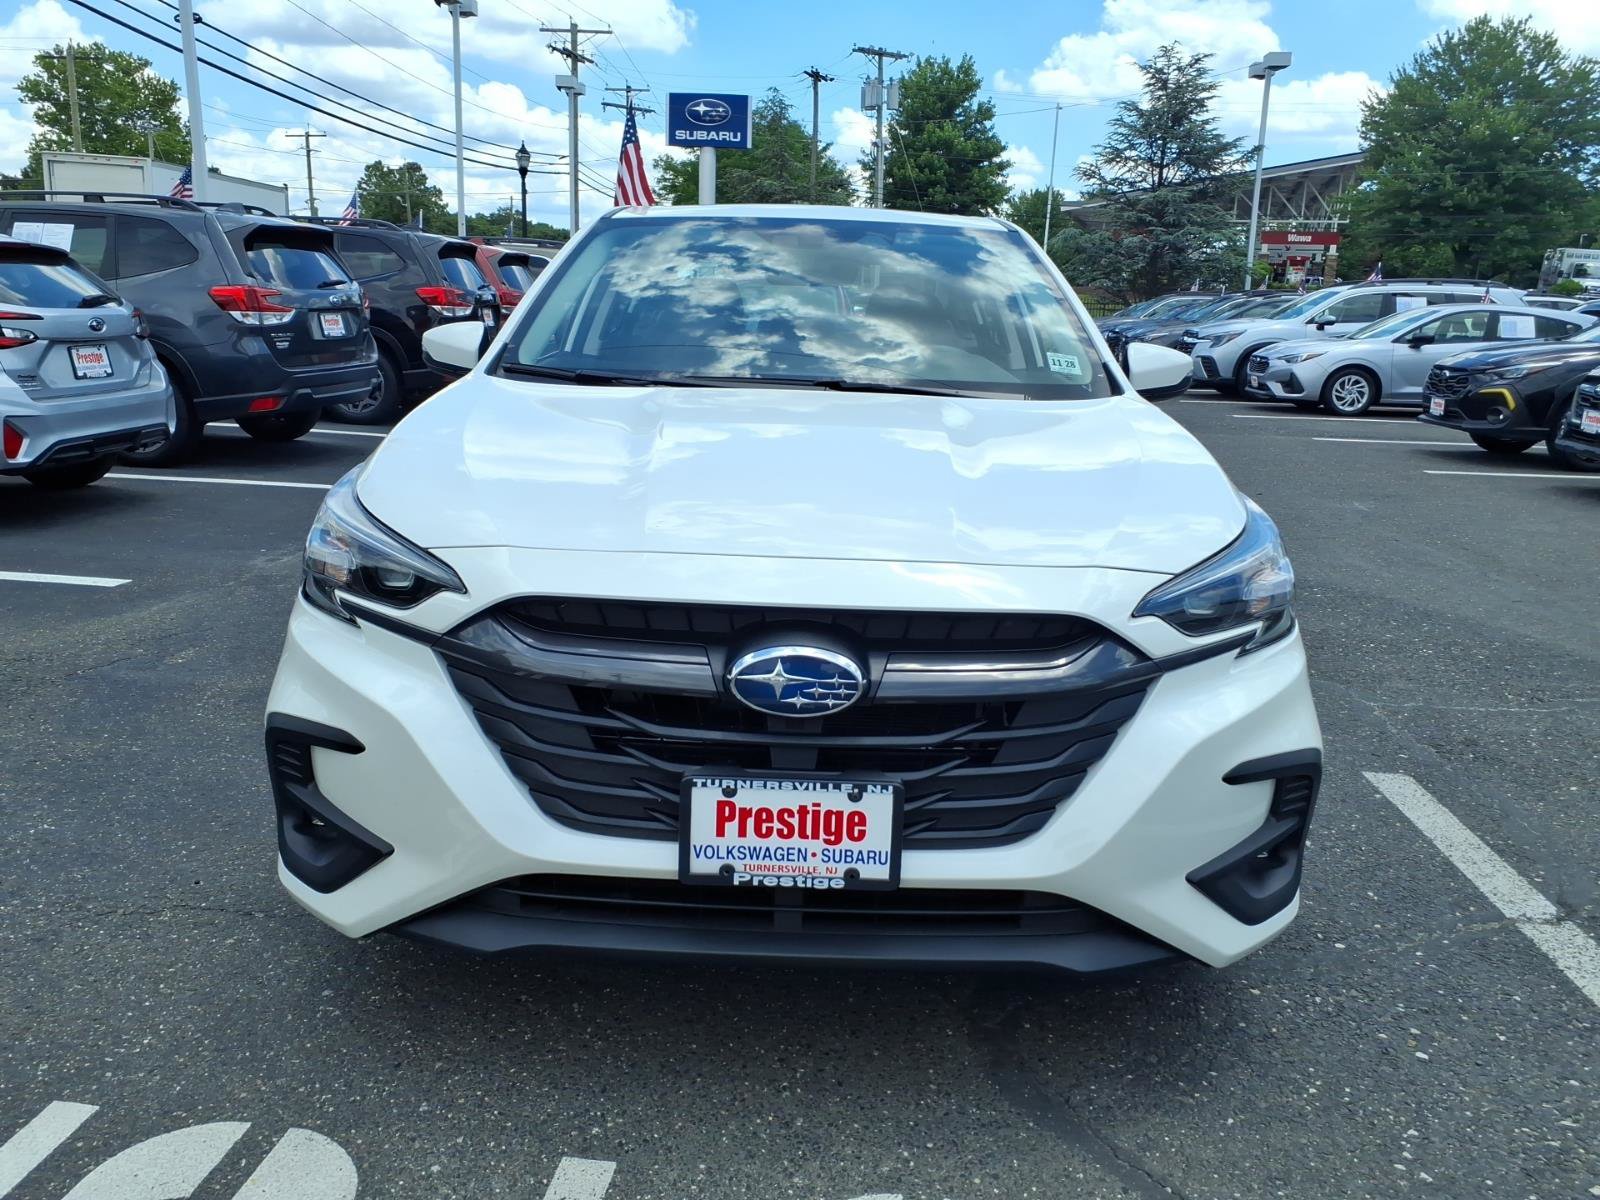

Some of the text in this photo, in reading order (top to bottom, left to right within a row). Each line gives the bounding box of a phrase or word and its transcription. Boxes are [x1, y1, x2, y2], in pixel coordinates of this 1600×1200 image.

[675, 130, 741, 142] SUBARU
[1288, 233, 1312, 242] Wawa
[76, 352, 105, 365] Prestige
[1051, 358, 1062, 367] 11
[866, 784, 894, 794] NJ
[716, 800, 867, 846] Prestige
[692, 844, 889, 866] VOLKSWAGEN SUBARU
[825, 866, 838, 875] NJ
[733, 872, 846, 890] Prestige
